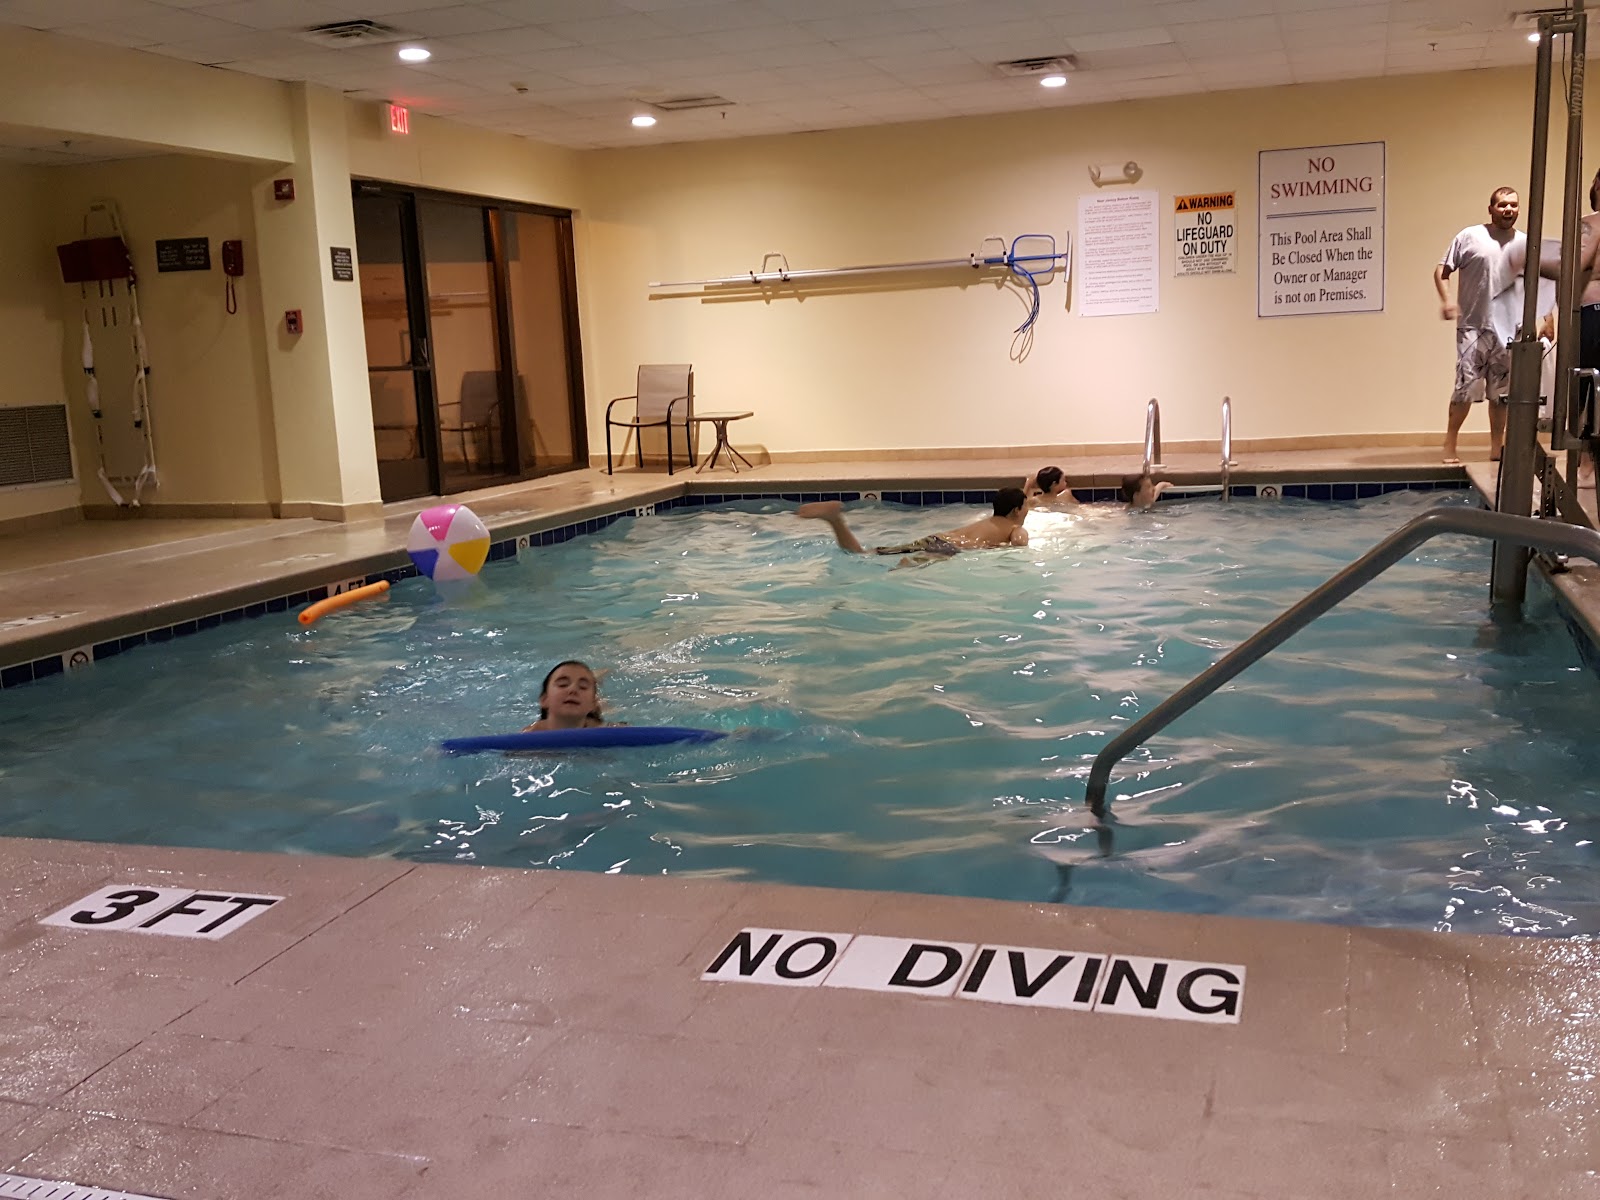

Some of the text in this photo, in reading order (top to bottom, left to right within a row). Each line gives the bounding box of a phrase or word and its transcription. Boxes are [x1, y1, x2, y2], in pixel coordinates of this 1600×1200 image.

[1571, 52, 1584, 116] SPECTRUM
[391, 105, 408, 134] EXIT
[1308, 157, 1335, 173] NO
[1271, 176, 1373, 199] SWIMMING
[1189, 194, 1233, 209] WARNING
[1198, 212, 1212, 225] NO
[1177, 225, 1233, 241] LIFEGUARD
[1270, 226, 1372, 246] This Pool Area Shall
[1183, 239, 1227, 255] ON DUTY
[1272, 247, 1373, 265] Be Closed When the
[1274, 268, 1368, 284] Owner or Manager
[1274, 287, 1367, 304] is not on Premises.
[70, 889, 279, 933] 3 FT
[705, 931, 1240, 1016] NO DIVING
